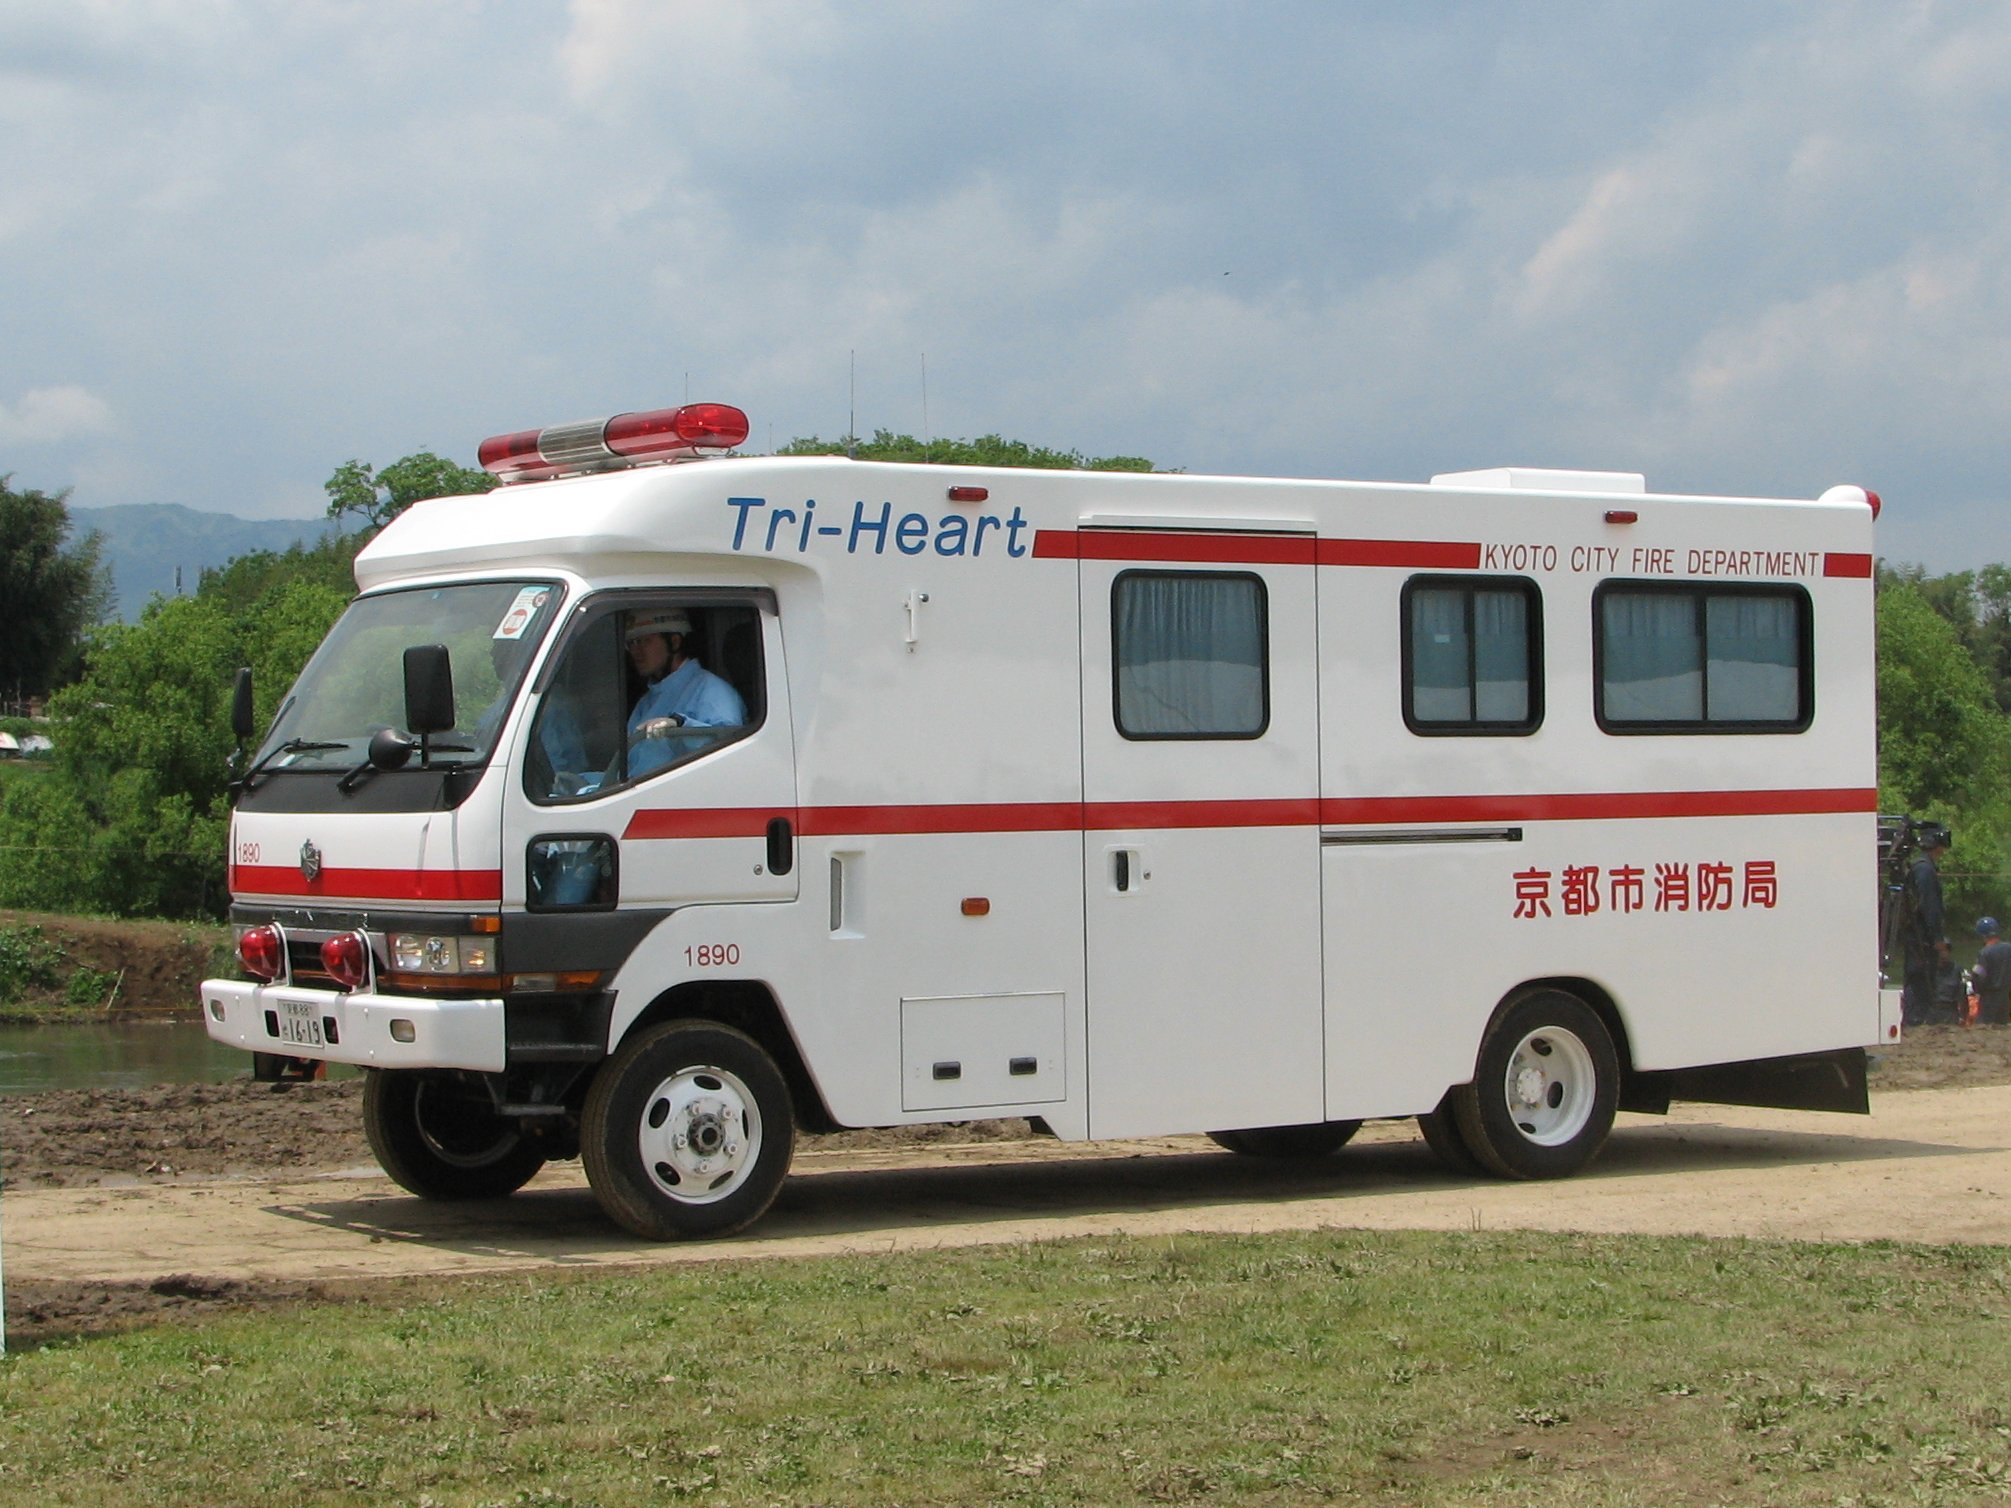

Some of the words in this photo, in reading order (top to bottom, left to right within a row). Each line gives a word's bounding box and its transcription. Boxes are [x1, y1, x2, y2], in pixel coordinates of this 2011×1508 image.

[727, 497, 1027, 558] Tri-Heart
[1484, 544, 1557, 570] KYOTO
[1571, 546, 1619, 572] CITY
[1632, 548, 1675, 573] FIRE
[1688, 550, 1820, 576] DEPARTMENT
[238, 842, 260, 863] 1890
[1513, 861, 1777, 918] 京都市消防局
[683, 943, 740, 967] 1890
